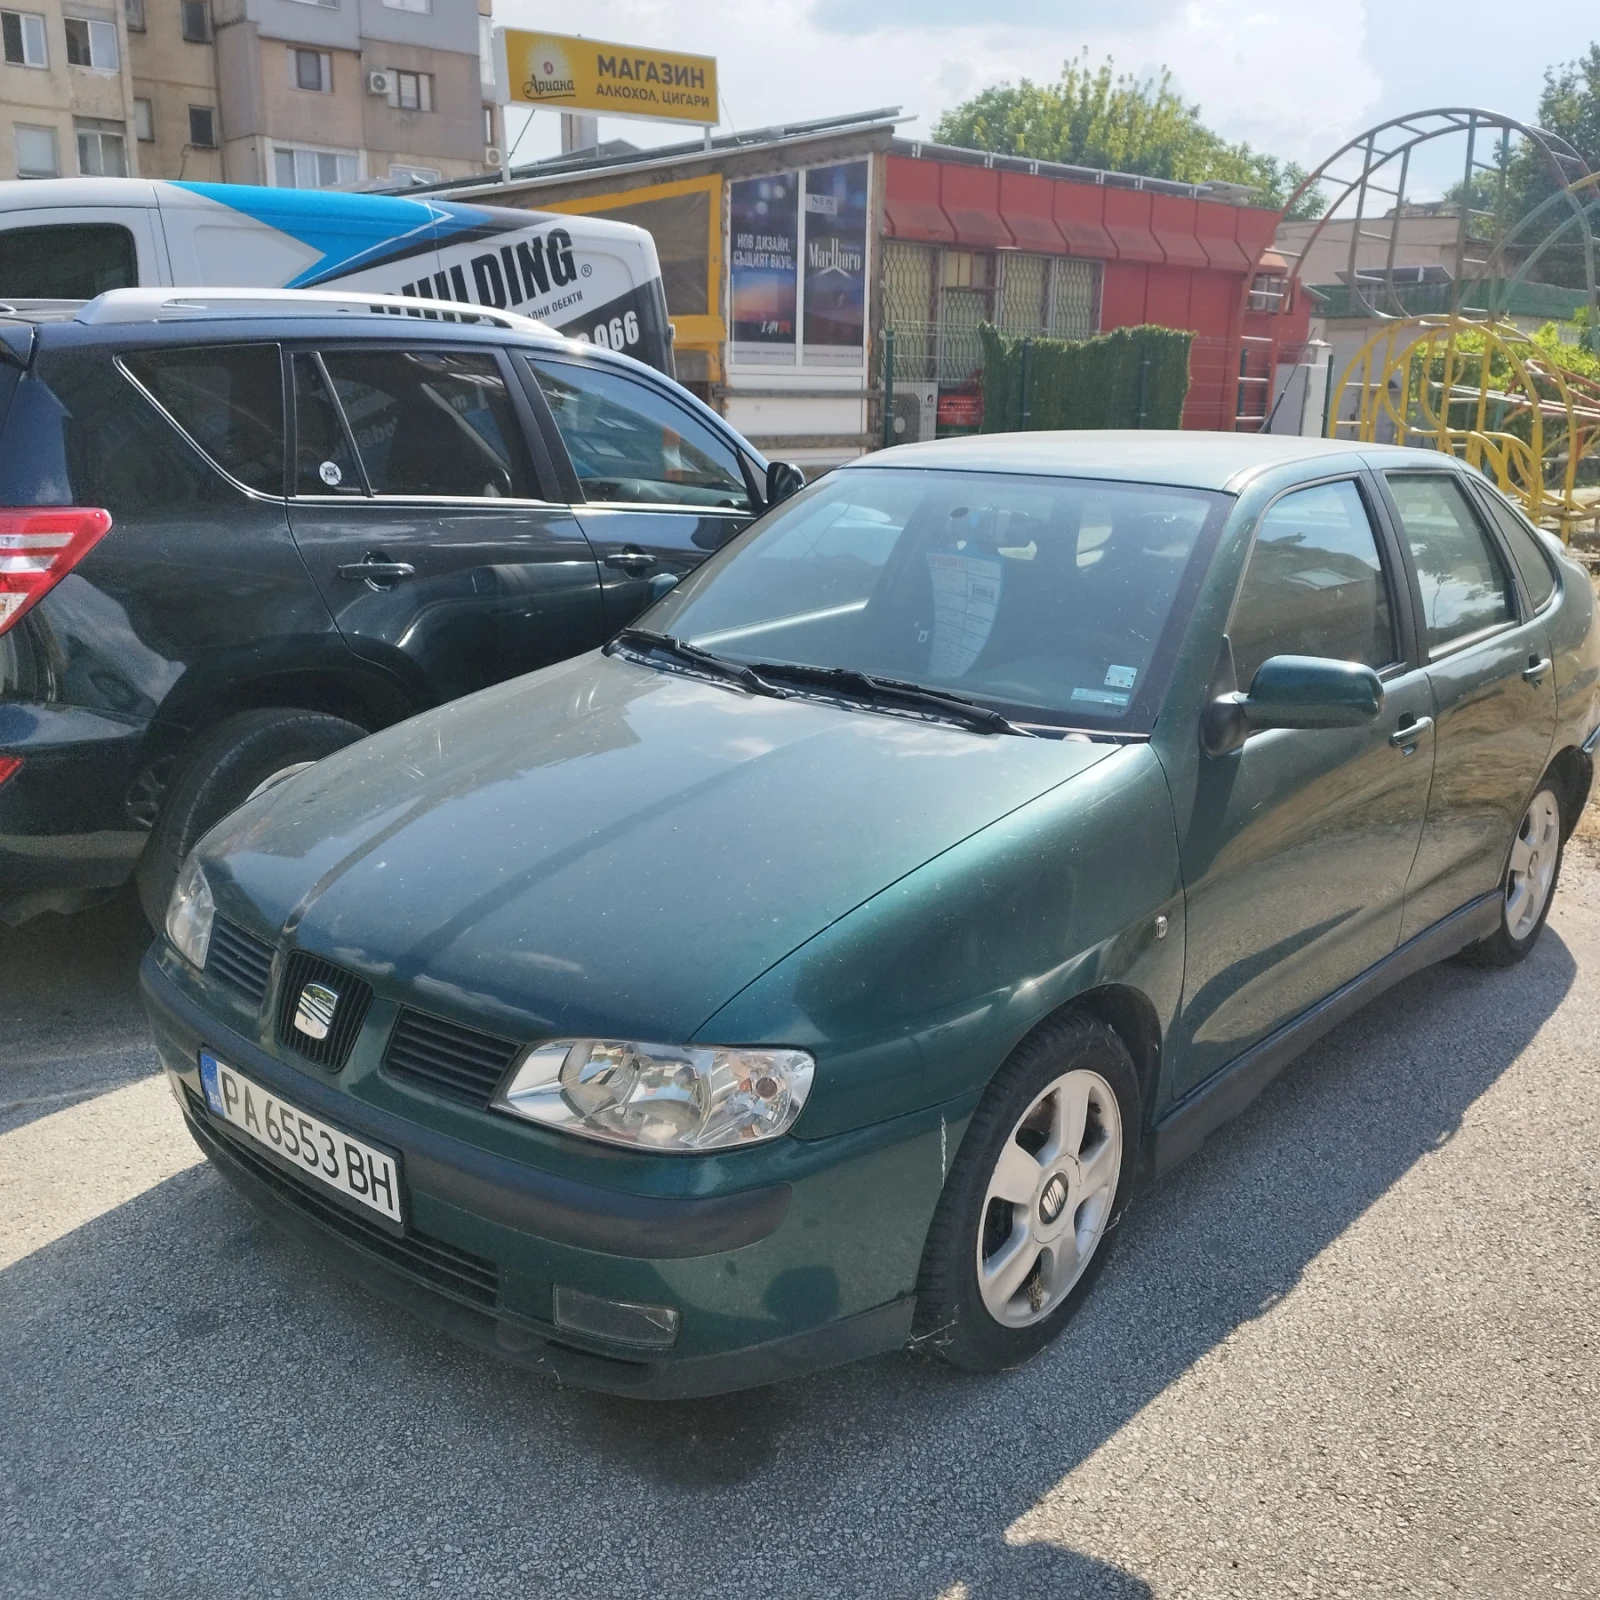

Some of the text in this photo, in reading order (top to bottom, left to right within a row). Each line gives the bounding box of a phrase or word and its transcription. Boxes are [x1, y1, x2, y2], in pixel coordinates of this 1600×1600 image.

[597, 54, 705, 89] МАГАЗИН
[522, 74, 576, 99] Ариана
[596, 83, 710, 108] АЛКОХОЛ, ЦИГАРИ
[812, 196, 834, 206] NEW
[737, 233, 754, 249] НОВ
[809, 238, 861, 270] Marlboro
[552, 290, 584, 313] ОБЕКТИ
